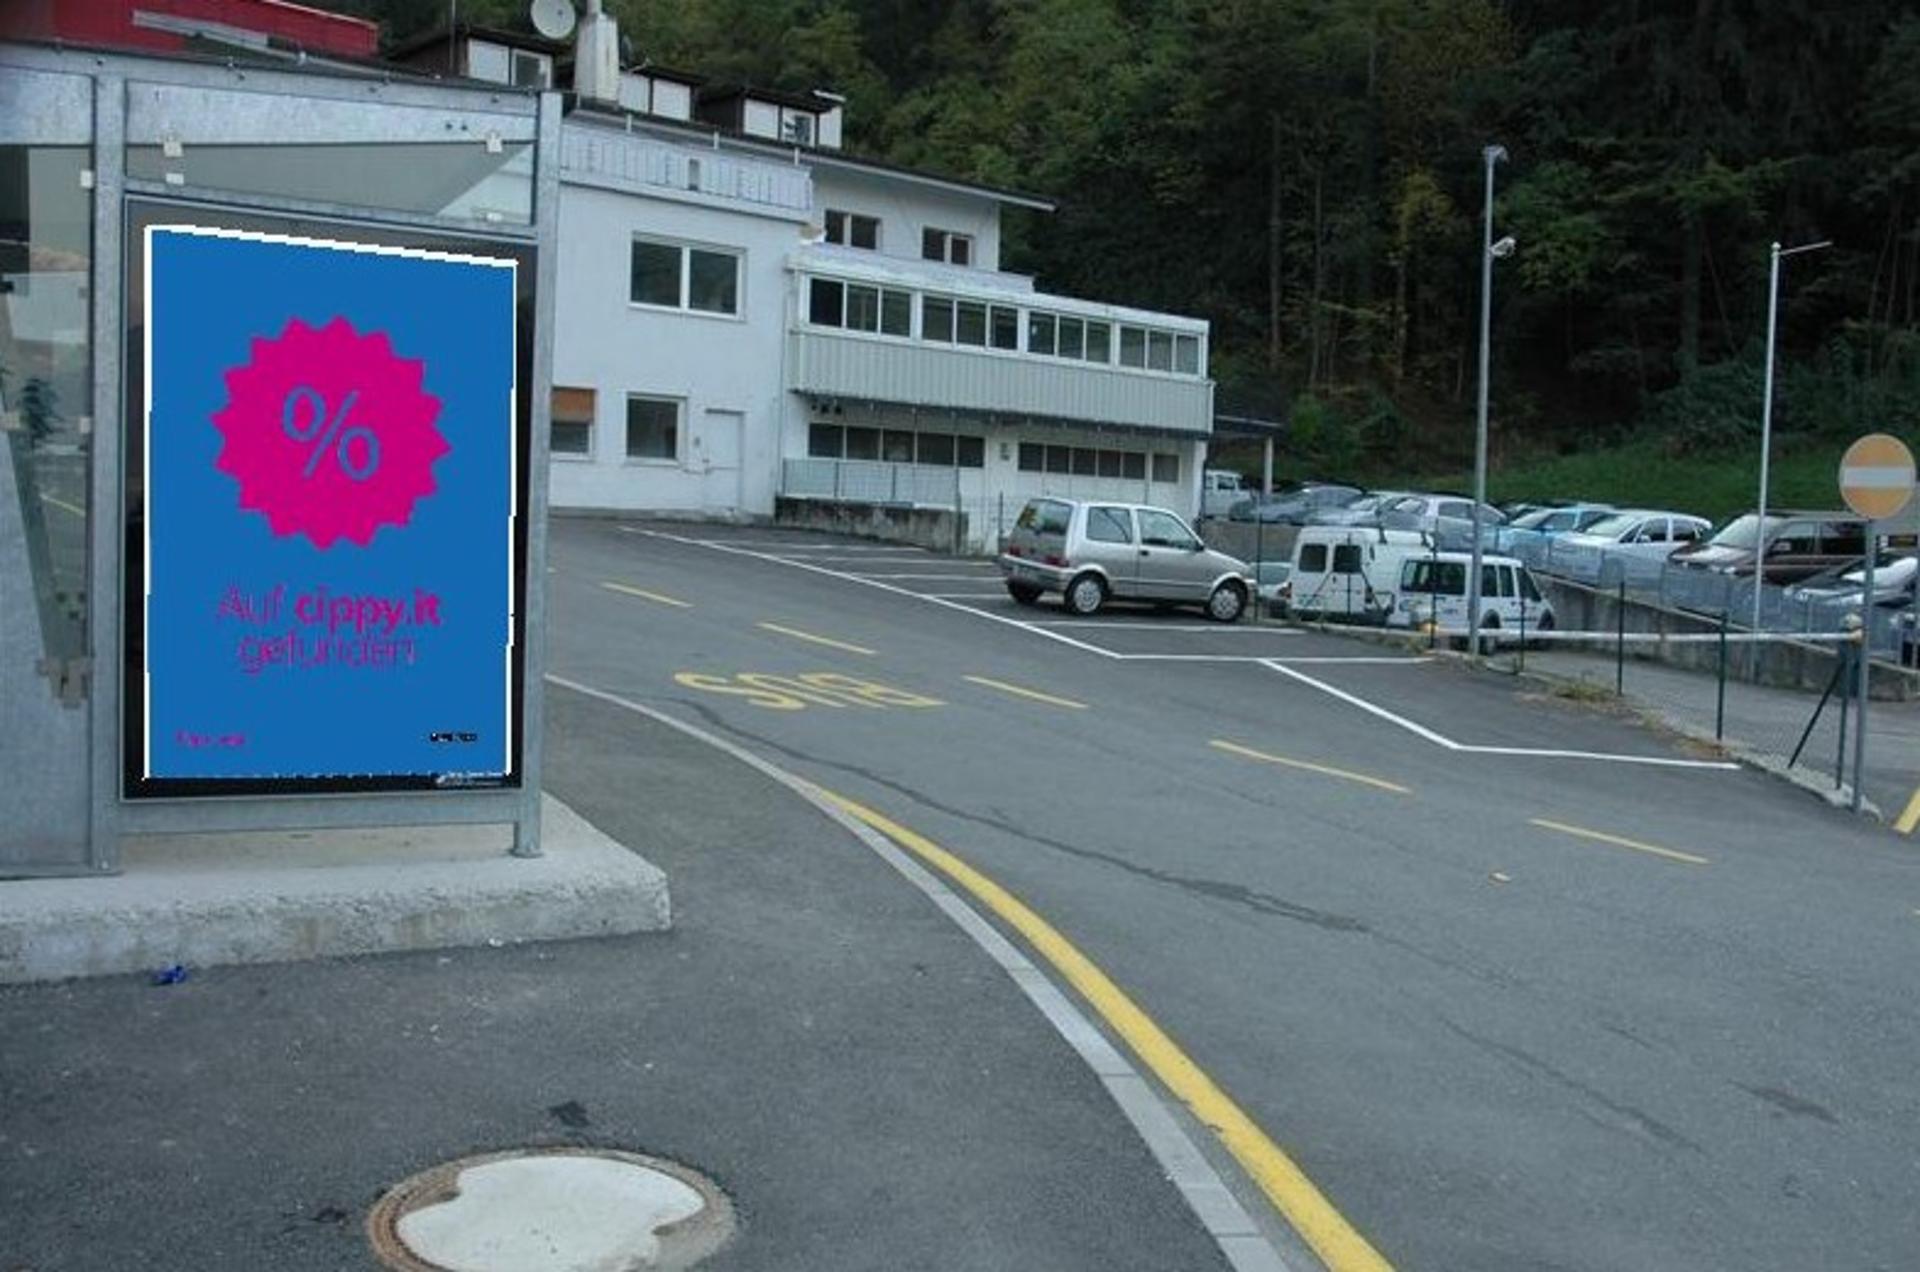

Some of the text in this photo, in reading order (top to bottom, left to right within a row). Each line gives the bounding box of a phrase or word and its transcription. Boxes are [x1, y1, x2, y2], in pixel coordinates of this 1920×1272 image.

[283, 384, 380, 480] %
[218, 583, 442, 635] Auf cippy.it
[236, 628, 415, 676] gefunden
[674, 672, 946, 710] BUS
